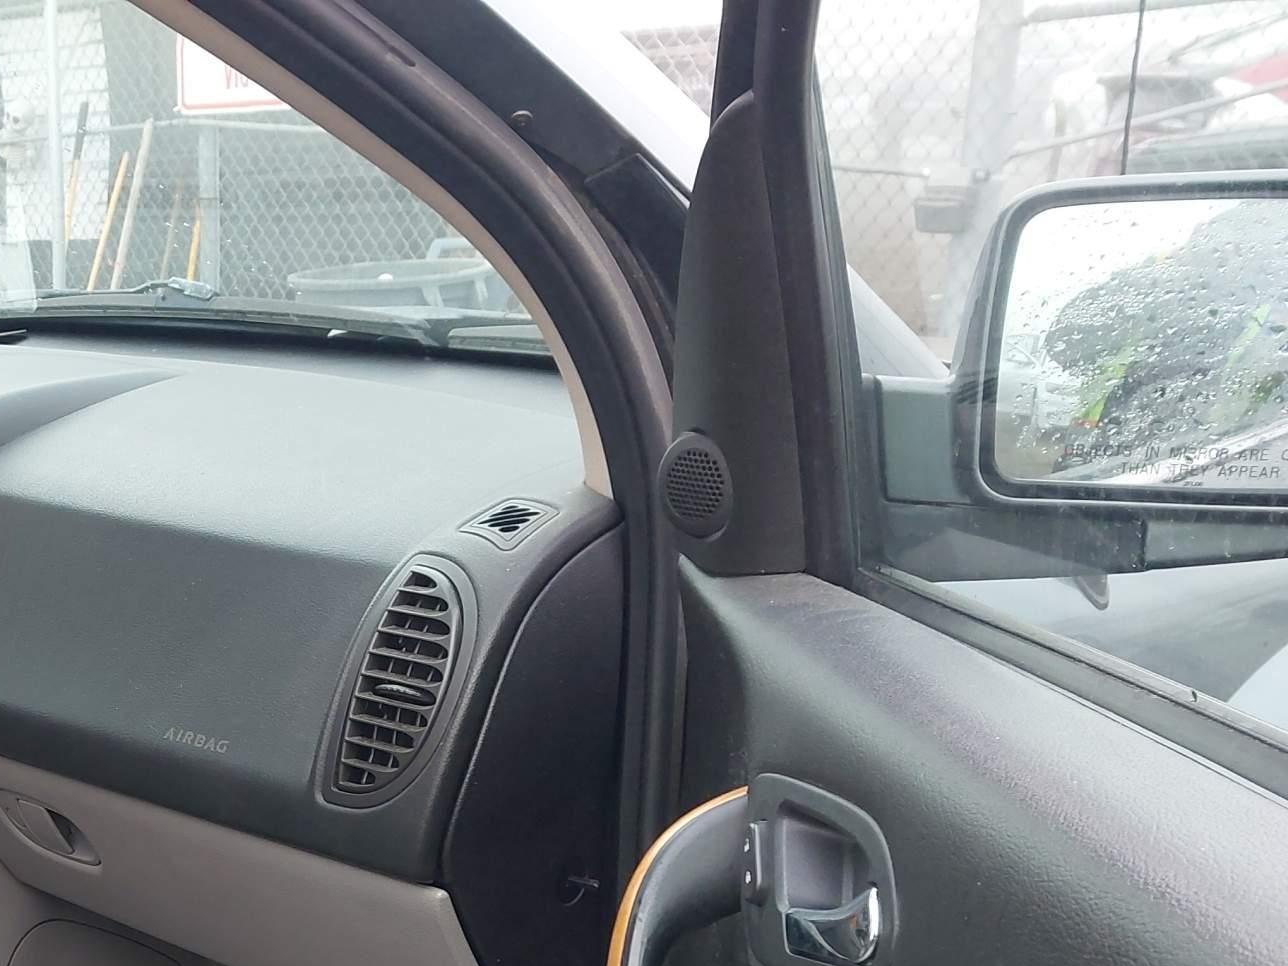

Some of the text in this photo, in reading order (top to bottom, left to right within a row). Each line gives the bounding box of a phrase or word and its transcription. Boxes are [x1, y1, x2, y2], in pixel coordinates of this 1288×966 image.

[1145, 446, 1160, 460] IN
[1169, 447, 1231, 461] MIRROR
[1238, 448, 1271, 462] ARE
[1121, 462, 1160, 475] THAN
[1218, 466, 1281, 480] APPEAR
[163, 727, 231, 753] AIRBAG
